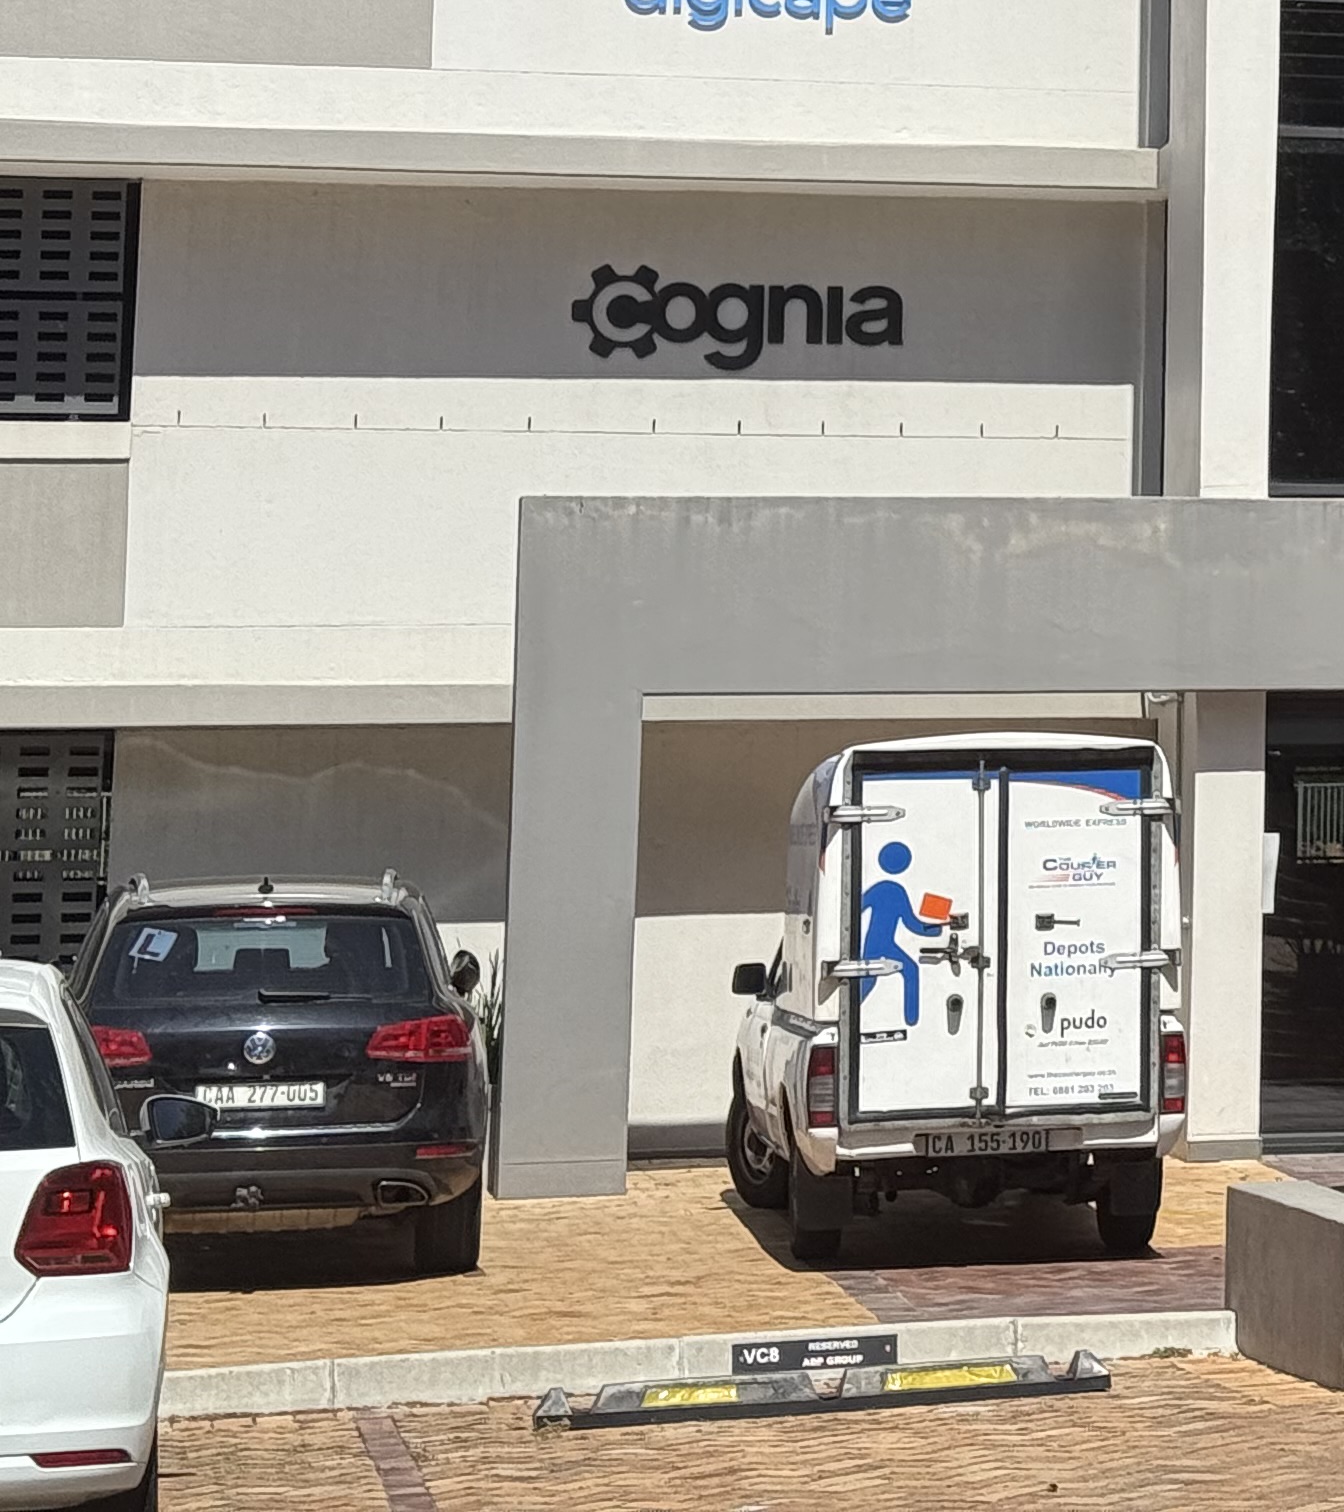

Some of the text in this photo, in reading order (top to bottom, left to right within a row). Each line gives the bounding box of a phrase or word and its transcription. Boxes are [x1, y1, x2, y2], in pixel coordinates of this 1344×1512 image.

[137, 933, 162, 958] L
[1044, 941, 1106, 958] Depots
[1060, 1008, 1107, 1038] pudo
[932, 1134, 955, 1154] CA
[808, 1339, 859, 1352] RESERVED
[743, 1346, 780, 1365] VC8
